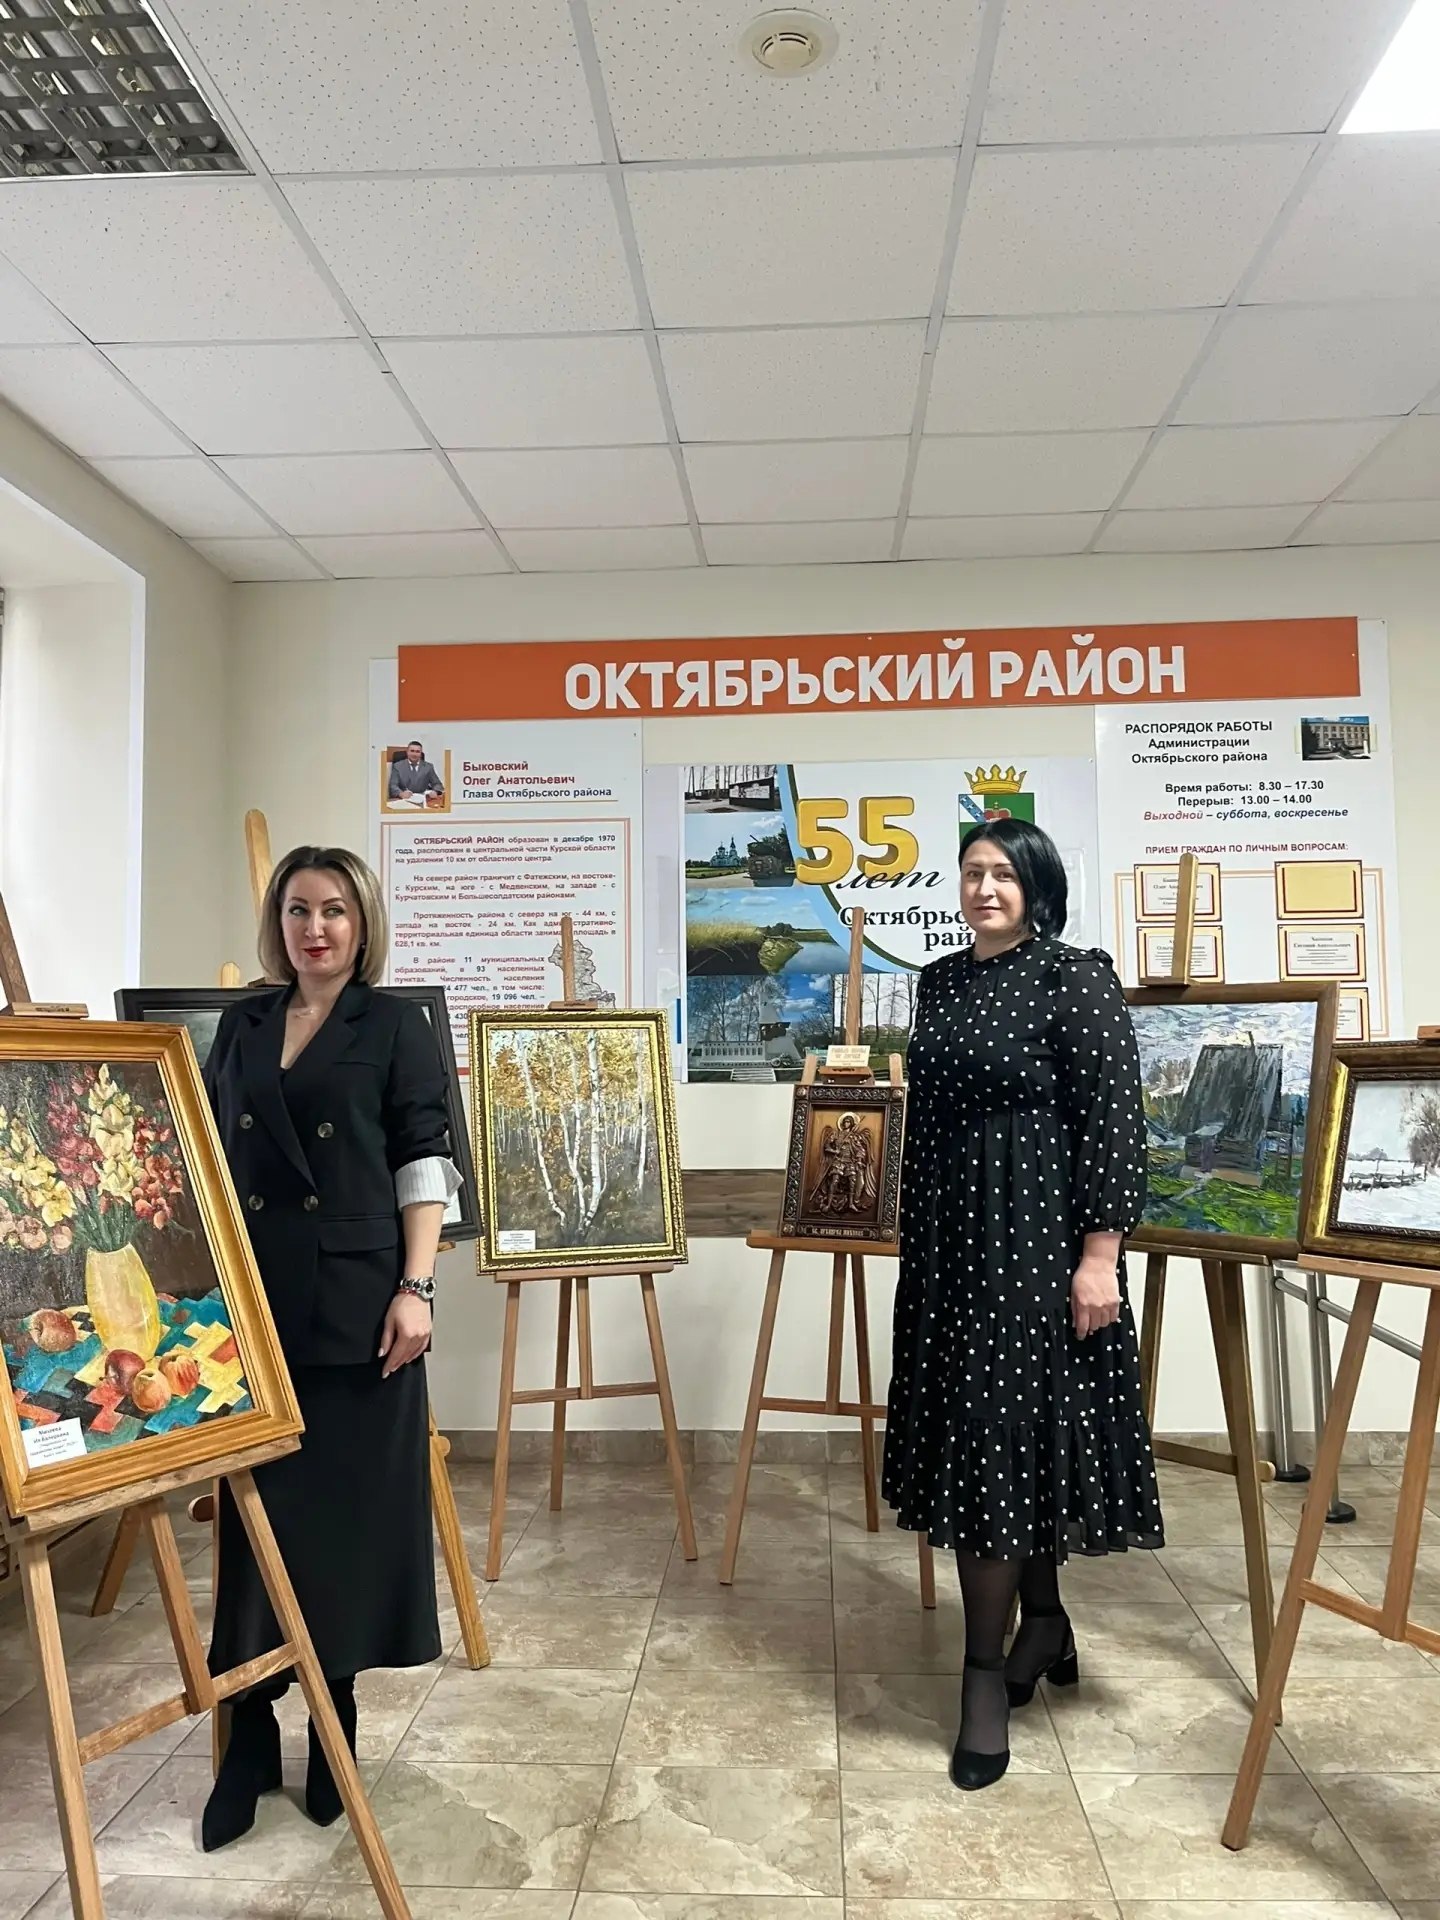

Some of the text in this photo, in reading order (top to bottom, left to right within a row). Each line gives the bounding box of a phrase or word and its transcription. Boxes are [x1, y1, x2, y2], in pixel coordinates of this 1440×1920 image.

[565, 633, 1185, 710] ОКТЯБРЬСКИЙ РАЙОН
[1125, 721, 1272, 734] РАСПОРЯДОК РАБОТЫ
[1148, 737, 1250, 749] Администрации
[1131, 751, 1268, 764] Октябрьского района
[463, 761, 529, 772] Быковский
[463, 775, 575, 786] Олег Анатольевич
[1165, 783, 1202, 794] Время
[1205, 782, 1252, 793] работы:
[1259, 781, 1282, 791] 8.30
[1295, 780, 1324, 790] 17.30
[463, 788, 612, 799] Глава Октябрьского района
[1178, 796, 1234, 808] Перерыв:
[1241, 795, 1270, 805] 13.00
[1283, 794, 1312, 804] 14.00
[1144, 810, 1203, 821] Выходной
[1216, 808, 1270, 820] суббота,
[1274, 808, 1348, 818] воскресенье
[414, 836, 472, 845] ОКТЯБРЬСКИЙ
[477, 835, 505, 844] РАЙОН
[508, 836, 549, 844] образован
[562, 835, 594, 844] декабре
[796, 795, 920, 885] 55
[417, 847, 464, 855] расположен
[473, 845, 524, 854] центральной
[550, 844, 581, 853] Курской
[1145, 846, 1178, 854] ПРИЕМ
[1181, 845, 1226, 854] ГРАЖДАН
[1245, 843, 1288, 853] ЛИЧНЫМ
[1291, 842, 1348, 852] ВОПРОСАМ:
[406, 857, 443, 865] удалении
[478, 854, 523, 862] областного
[454, 874, 478, 882] район
[480, 874, 515, 882] граничит
[836, 870, 946, 890] лет
[395, 893, 449, 902] Курчатовским
[458, 892, 534, 901] Большесолдатским
[413, 912, 473, 920] Протяженность
[477, 911, 505, 919] района
[839, 906, 966, 930] Октябрьс
[544, 920, 616, 928] адмстративно-
[395, 931, 463, 939] территориальная
[465, 931, 499, 939] единица
[501, 929, 532, 937] области
[535, 929, 562, 937] занима
[573, 928, 609, 936] площадь
[924, 926, 973, 951] рай
[428, 957, 456, 965] районе
